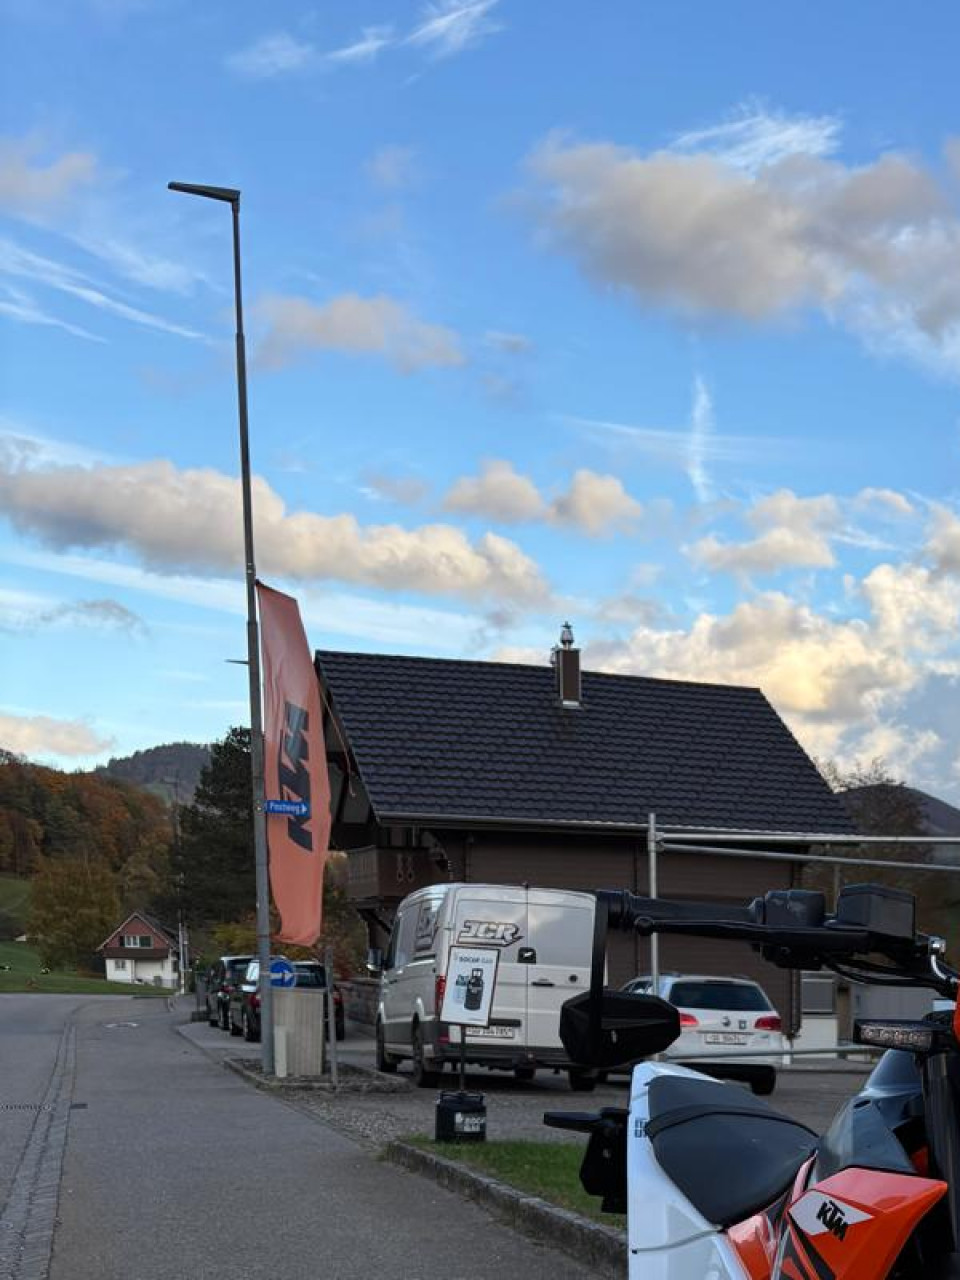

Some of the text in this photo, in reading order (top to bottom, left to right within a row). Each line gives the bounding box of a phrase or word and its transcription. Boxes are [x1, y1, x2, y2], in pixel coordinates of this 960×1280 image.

[277, 702, 313, 851] KTM
[460, 920, 522, 943] JCR
[816, 1200, 849, 1242] KTM
